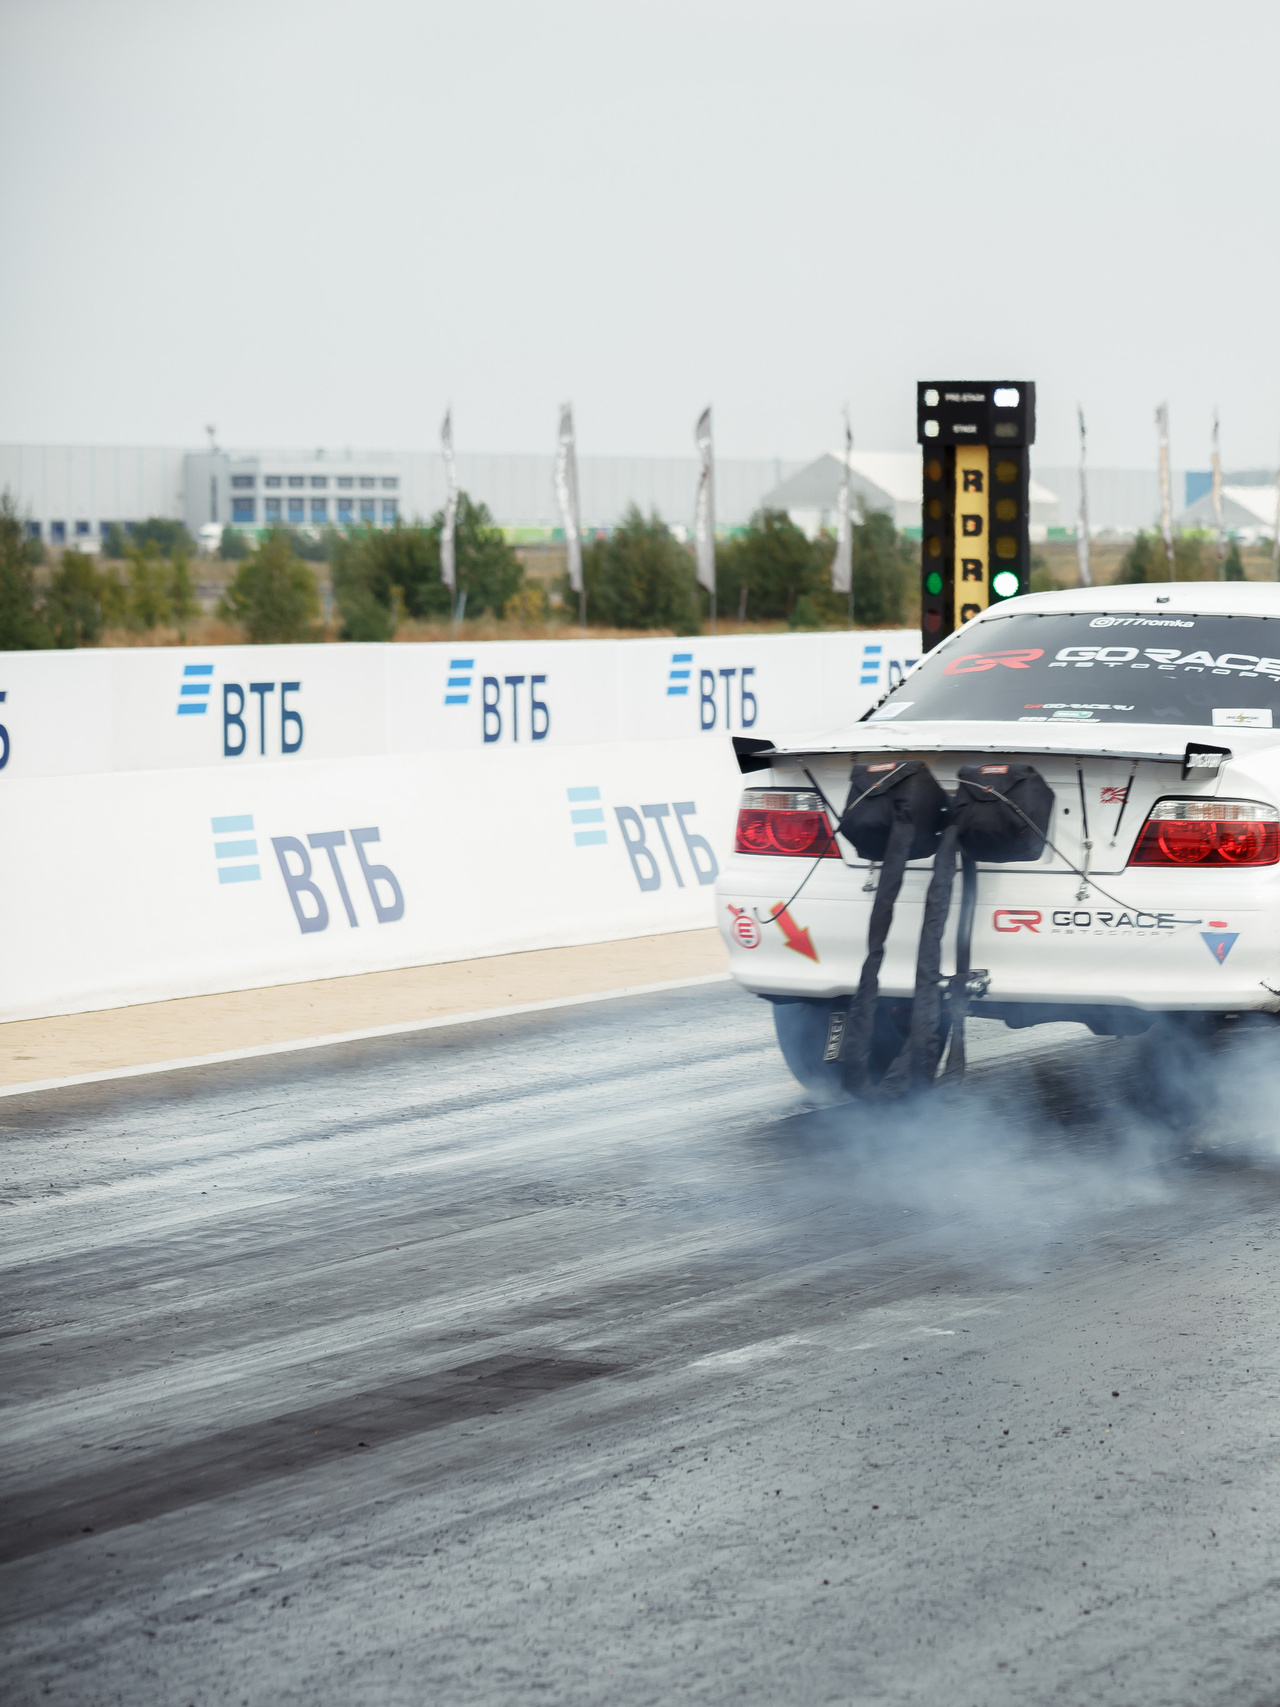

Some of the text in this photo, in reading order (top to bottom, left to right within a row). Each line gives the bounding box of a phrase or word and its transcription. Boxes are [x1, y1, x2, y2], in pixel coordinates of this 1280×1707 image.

[223, 681, 304, 757] ВТБ
[482, 674, 550, 743] ВТБ
[700, 667, 757, 730] ВТБ
[270, 826, 406, 935] ВТБ
[614, 801, 720, 892] ВТБ
[993, 909, 1043, 933] GR
